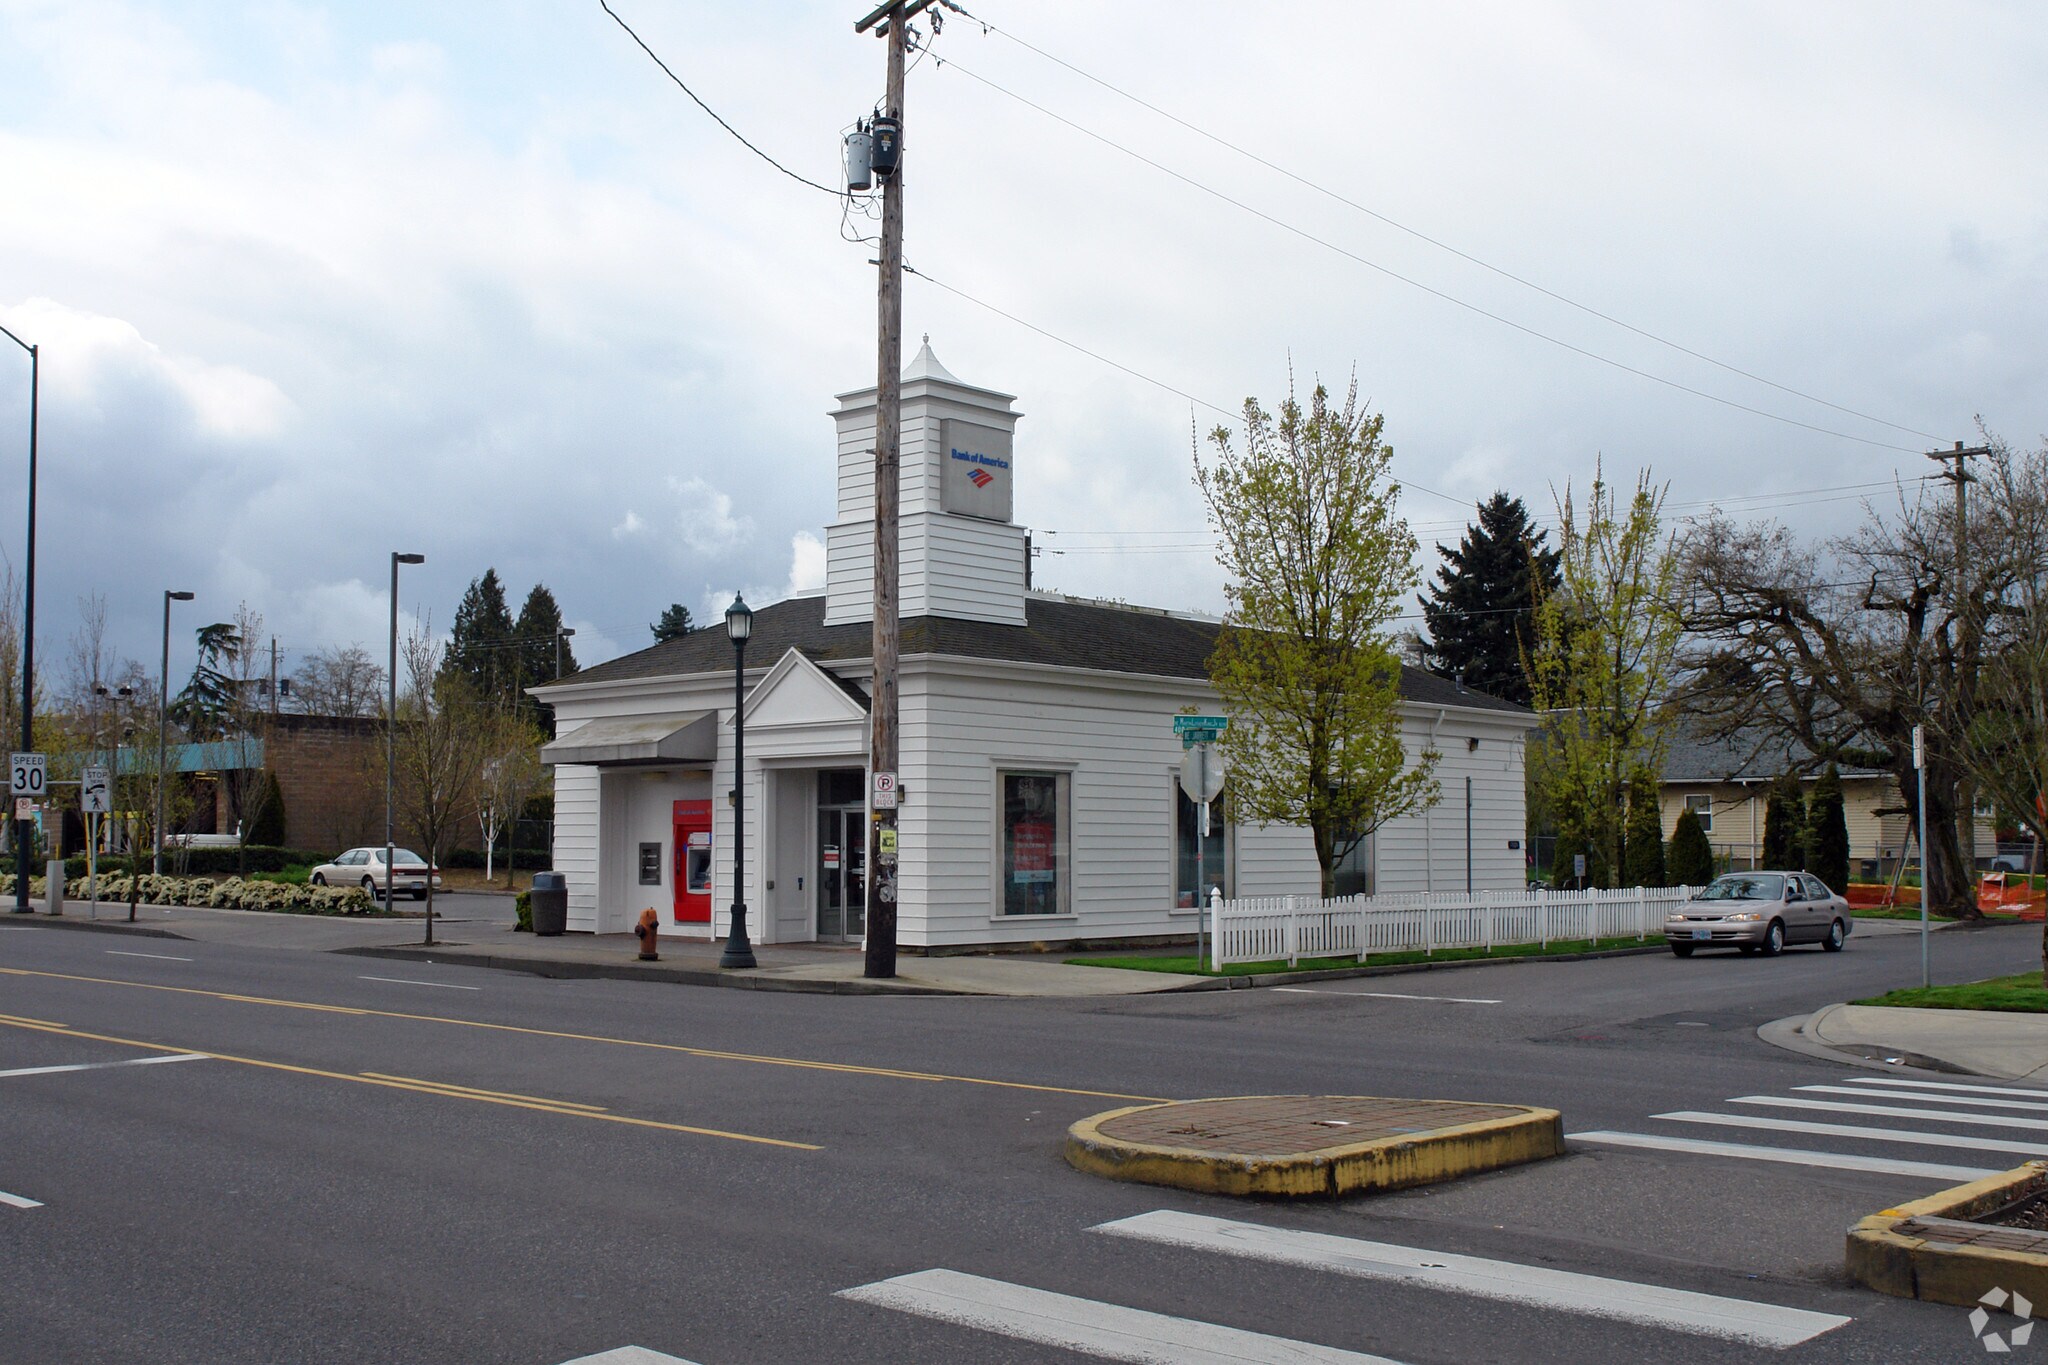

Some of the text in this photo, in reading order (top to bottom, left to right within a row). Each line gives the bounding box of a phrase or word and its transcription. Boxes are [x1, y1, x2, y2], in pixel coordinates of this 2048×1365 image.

[952, 448, 1008, 469] Bank of America
[13, 757, 44, 765] SPEED
[14, 767, 42, 790] 30
